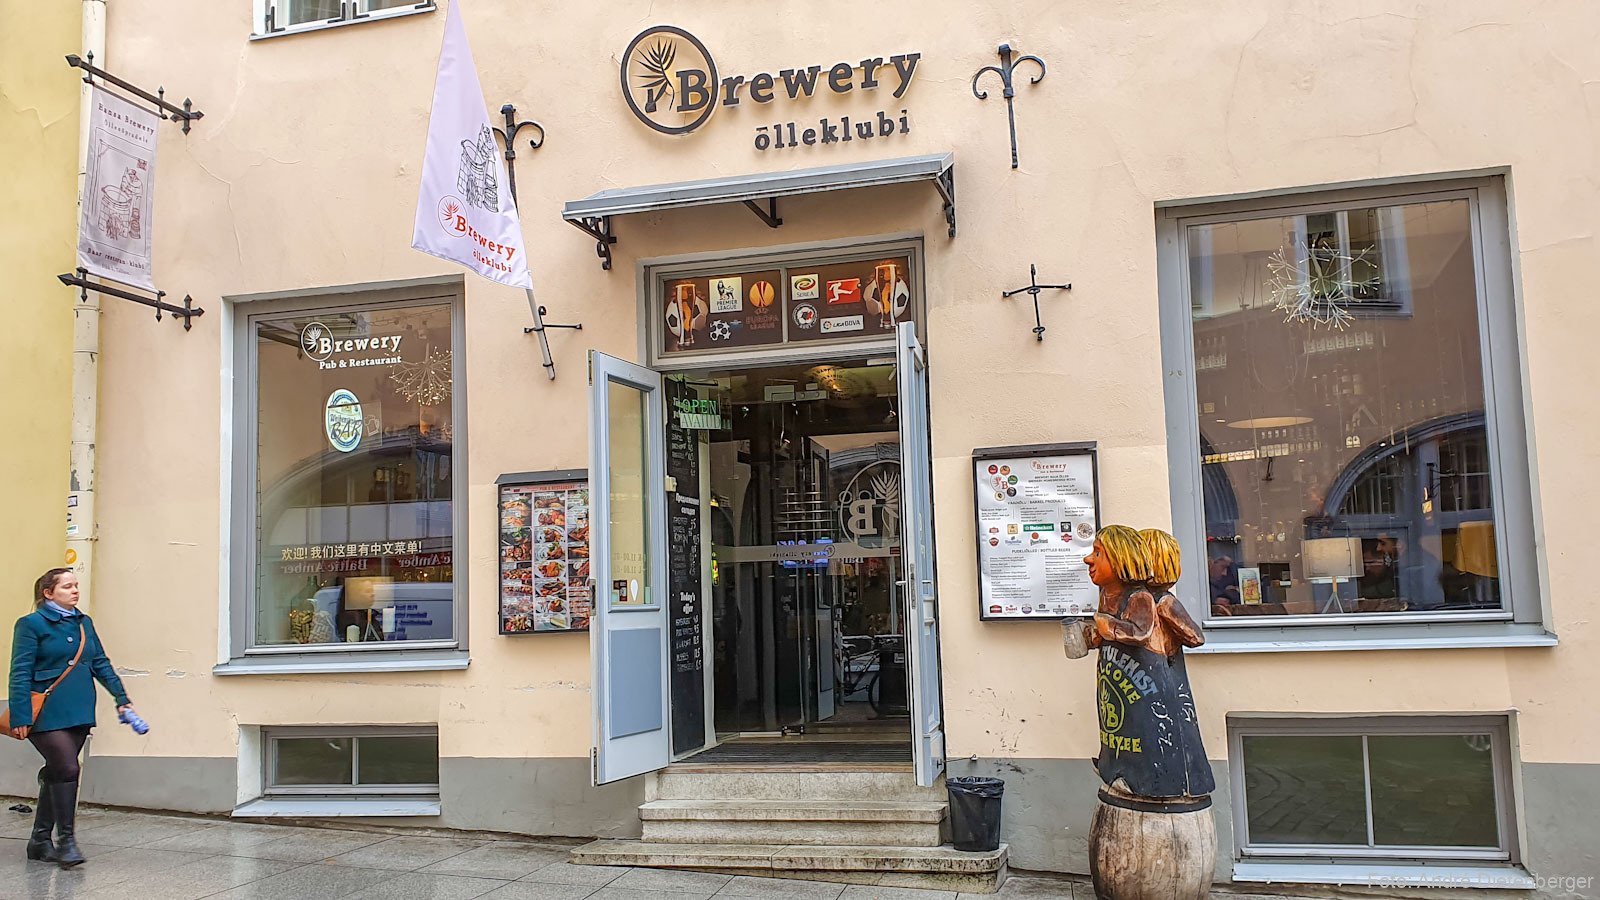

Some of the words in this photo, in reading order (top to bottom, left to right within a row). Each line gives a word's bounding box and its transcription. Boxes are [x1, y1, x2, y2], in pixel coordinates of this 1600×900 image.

[675, 52, 922, 112] Brewery
[124, 115, 155, 136] Brewery
[454, 214, 516, 261] Brewery
[319, 335, 402, 354] Brewery
[319, 360, 337, 370] Pub
[338, 359, 347, 368] &
[349, 355, 402, 368] Restaurant
[682, 398, 717, 415] OPEN
[1102, 645, 1159, 697] TULEMAST
[1105, 702, 1119, 728] B
